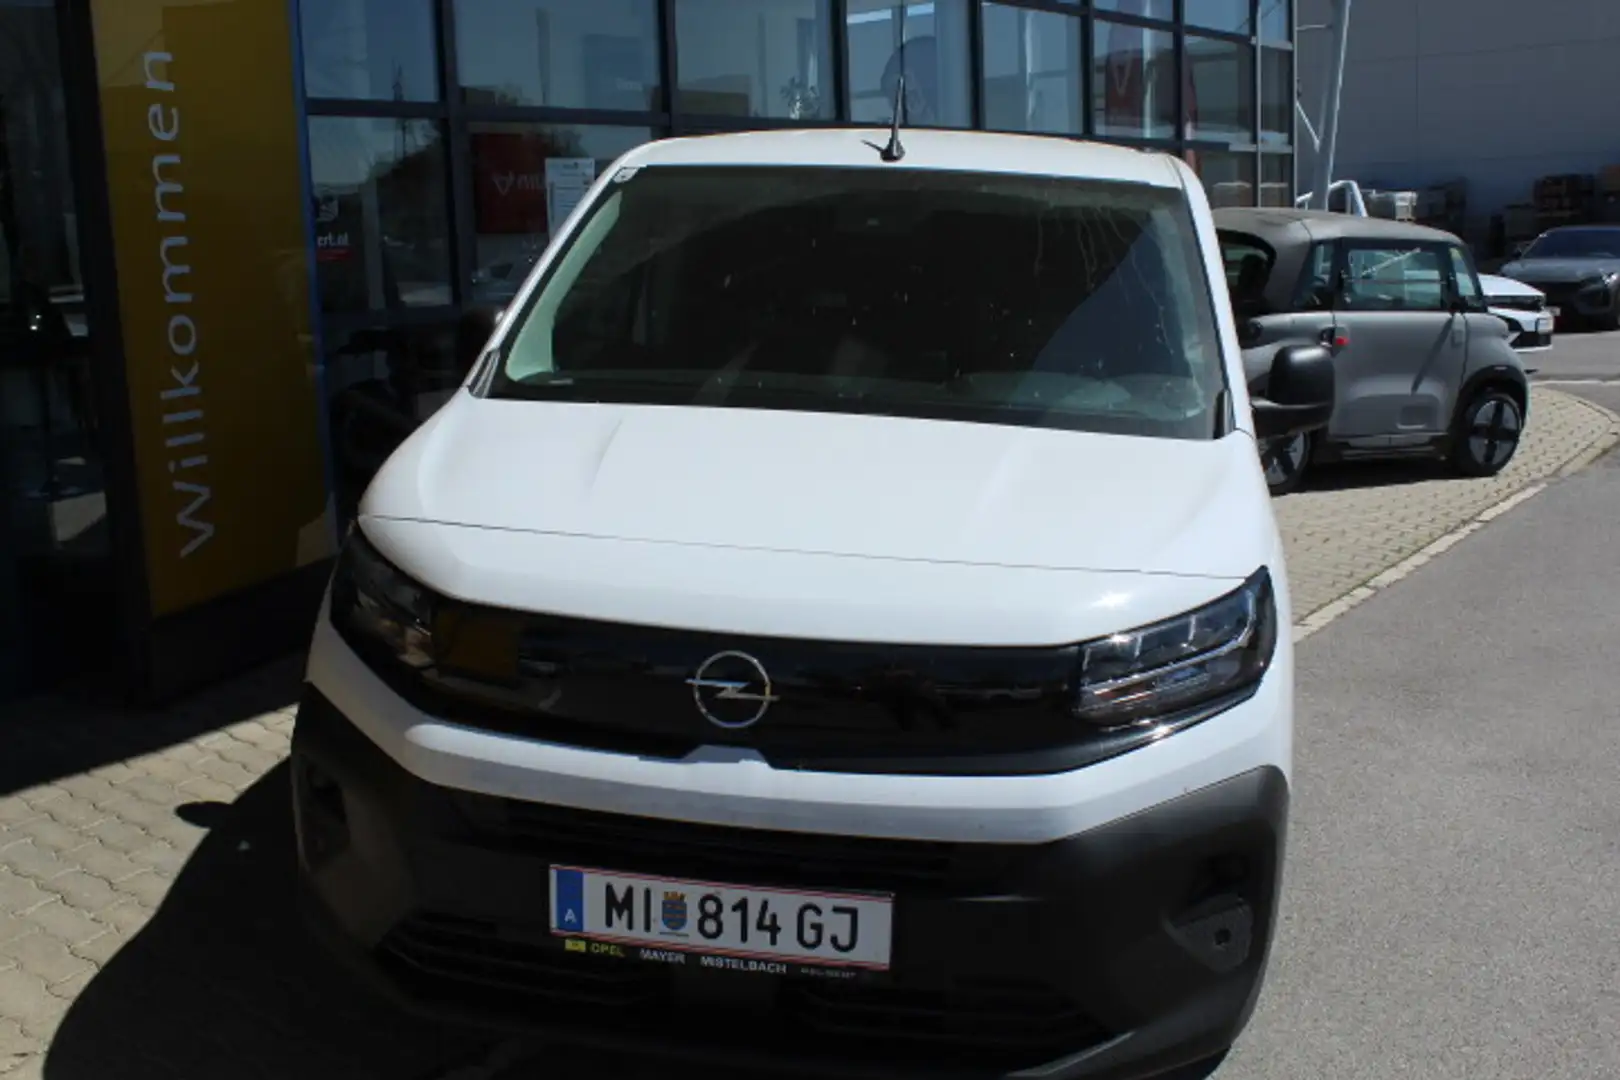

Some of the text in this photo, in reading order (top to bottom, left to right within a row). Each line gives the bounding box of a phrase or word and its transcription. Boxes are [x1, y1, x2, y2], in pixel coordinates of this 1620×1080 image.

[142, 50, 214, 559] Willkommen
[564, 908, 577, 924] A
[604, 882, 859, 953] MI 814 GJ
[590, 943, 624, 957] OPEL
[639, 948, 686, 964] MAYER
[700, 955, 787, 974] MISTELBACH
